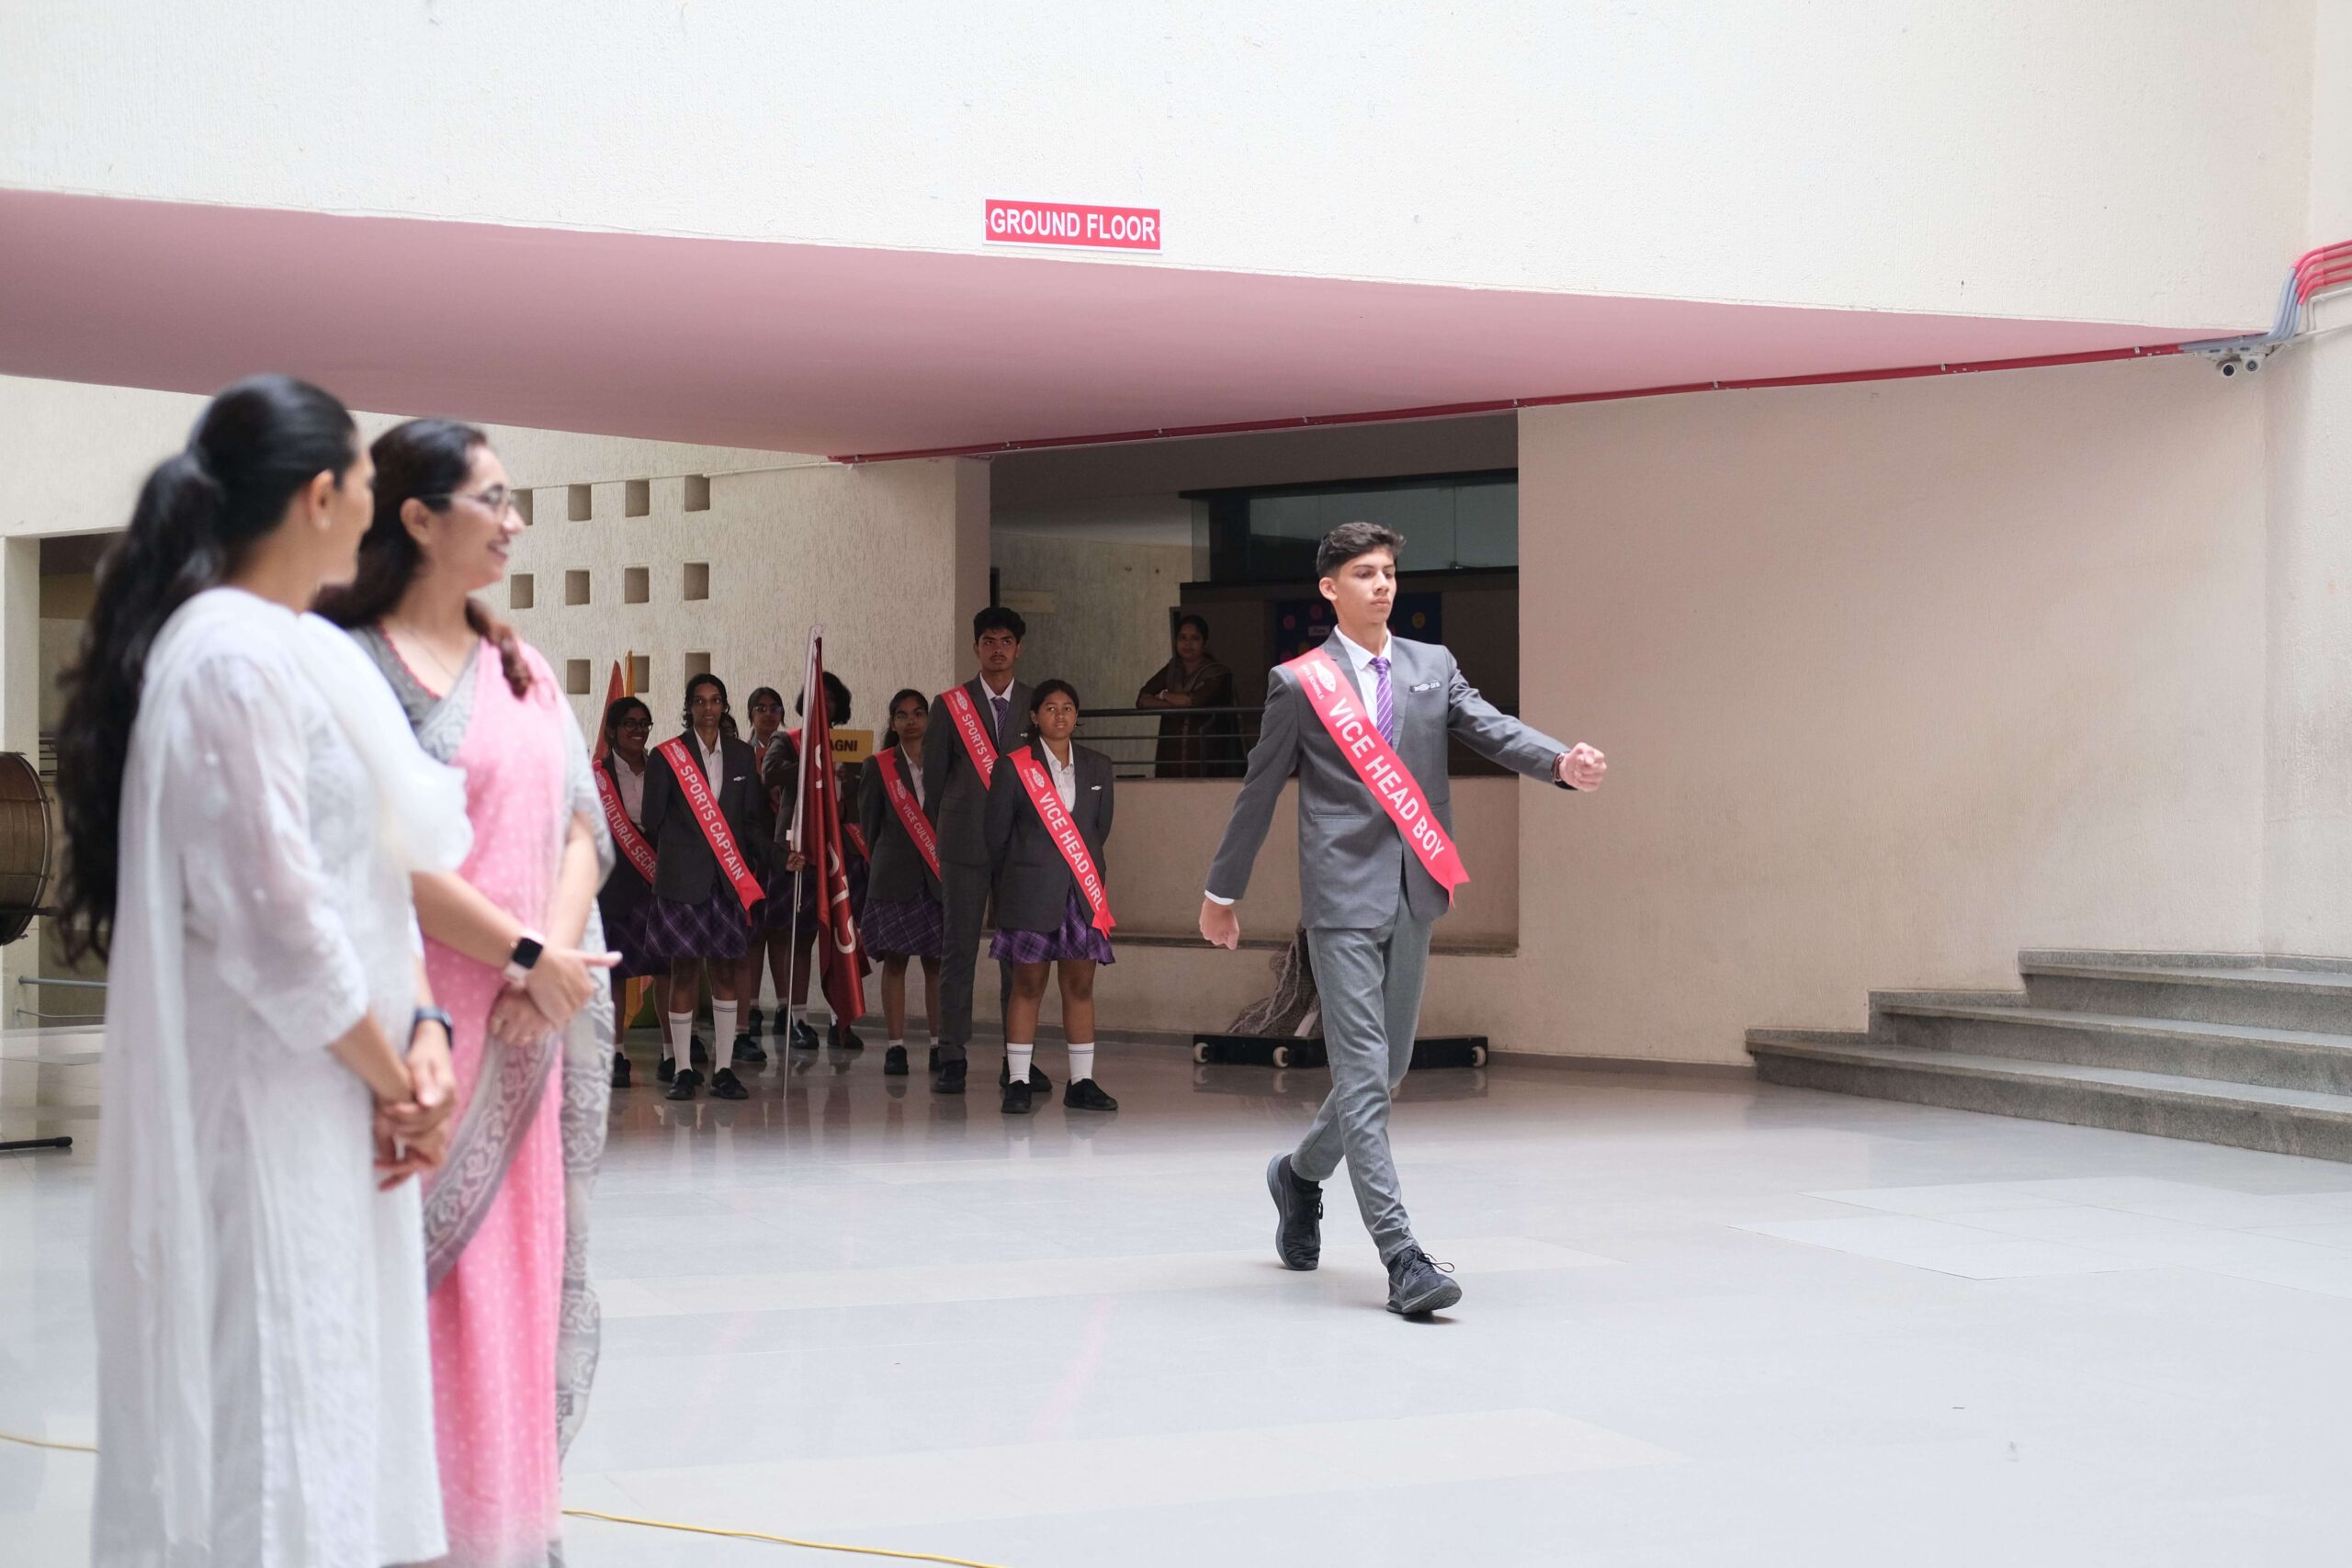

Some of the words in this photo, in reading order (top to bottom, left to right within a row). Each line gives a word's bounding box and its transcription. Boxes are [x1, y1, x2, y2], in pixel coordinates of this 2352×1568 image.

[990, 208, 1080, 238] GROUND
[1087, 213, 1157, 242] FLOOR
[962, 713, 988, 755] SPORTS
[1329, 697, 1376, 759] VICE
[1364, 755, 1419, 821] HEAD
[1412, 815, 1445, 861] BOY
[602, 794, 636, 850] CULTURAL
[680, 765, 717, 822] SPORTS
[709, 821, 745, 881] CAPTAIN
[902, 803, 918, 823] VICE
[1039, 791, 1069, 831] VICE
[1059, 829, 1091, 874] HEAD
[1084, 874, 1104, 911] GIRL
